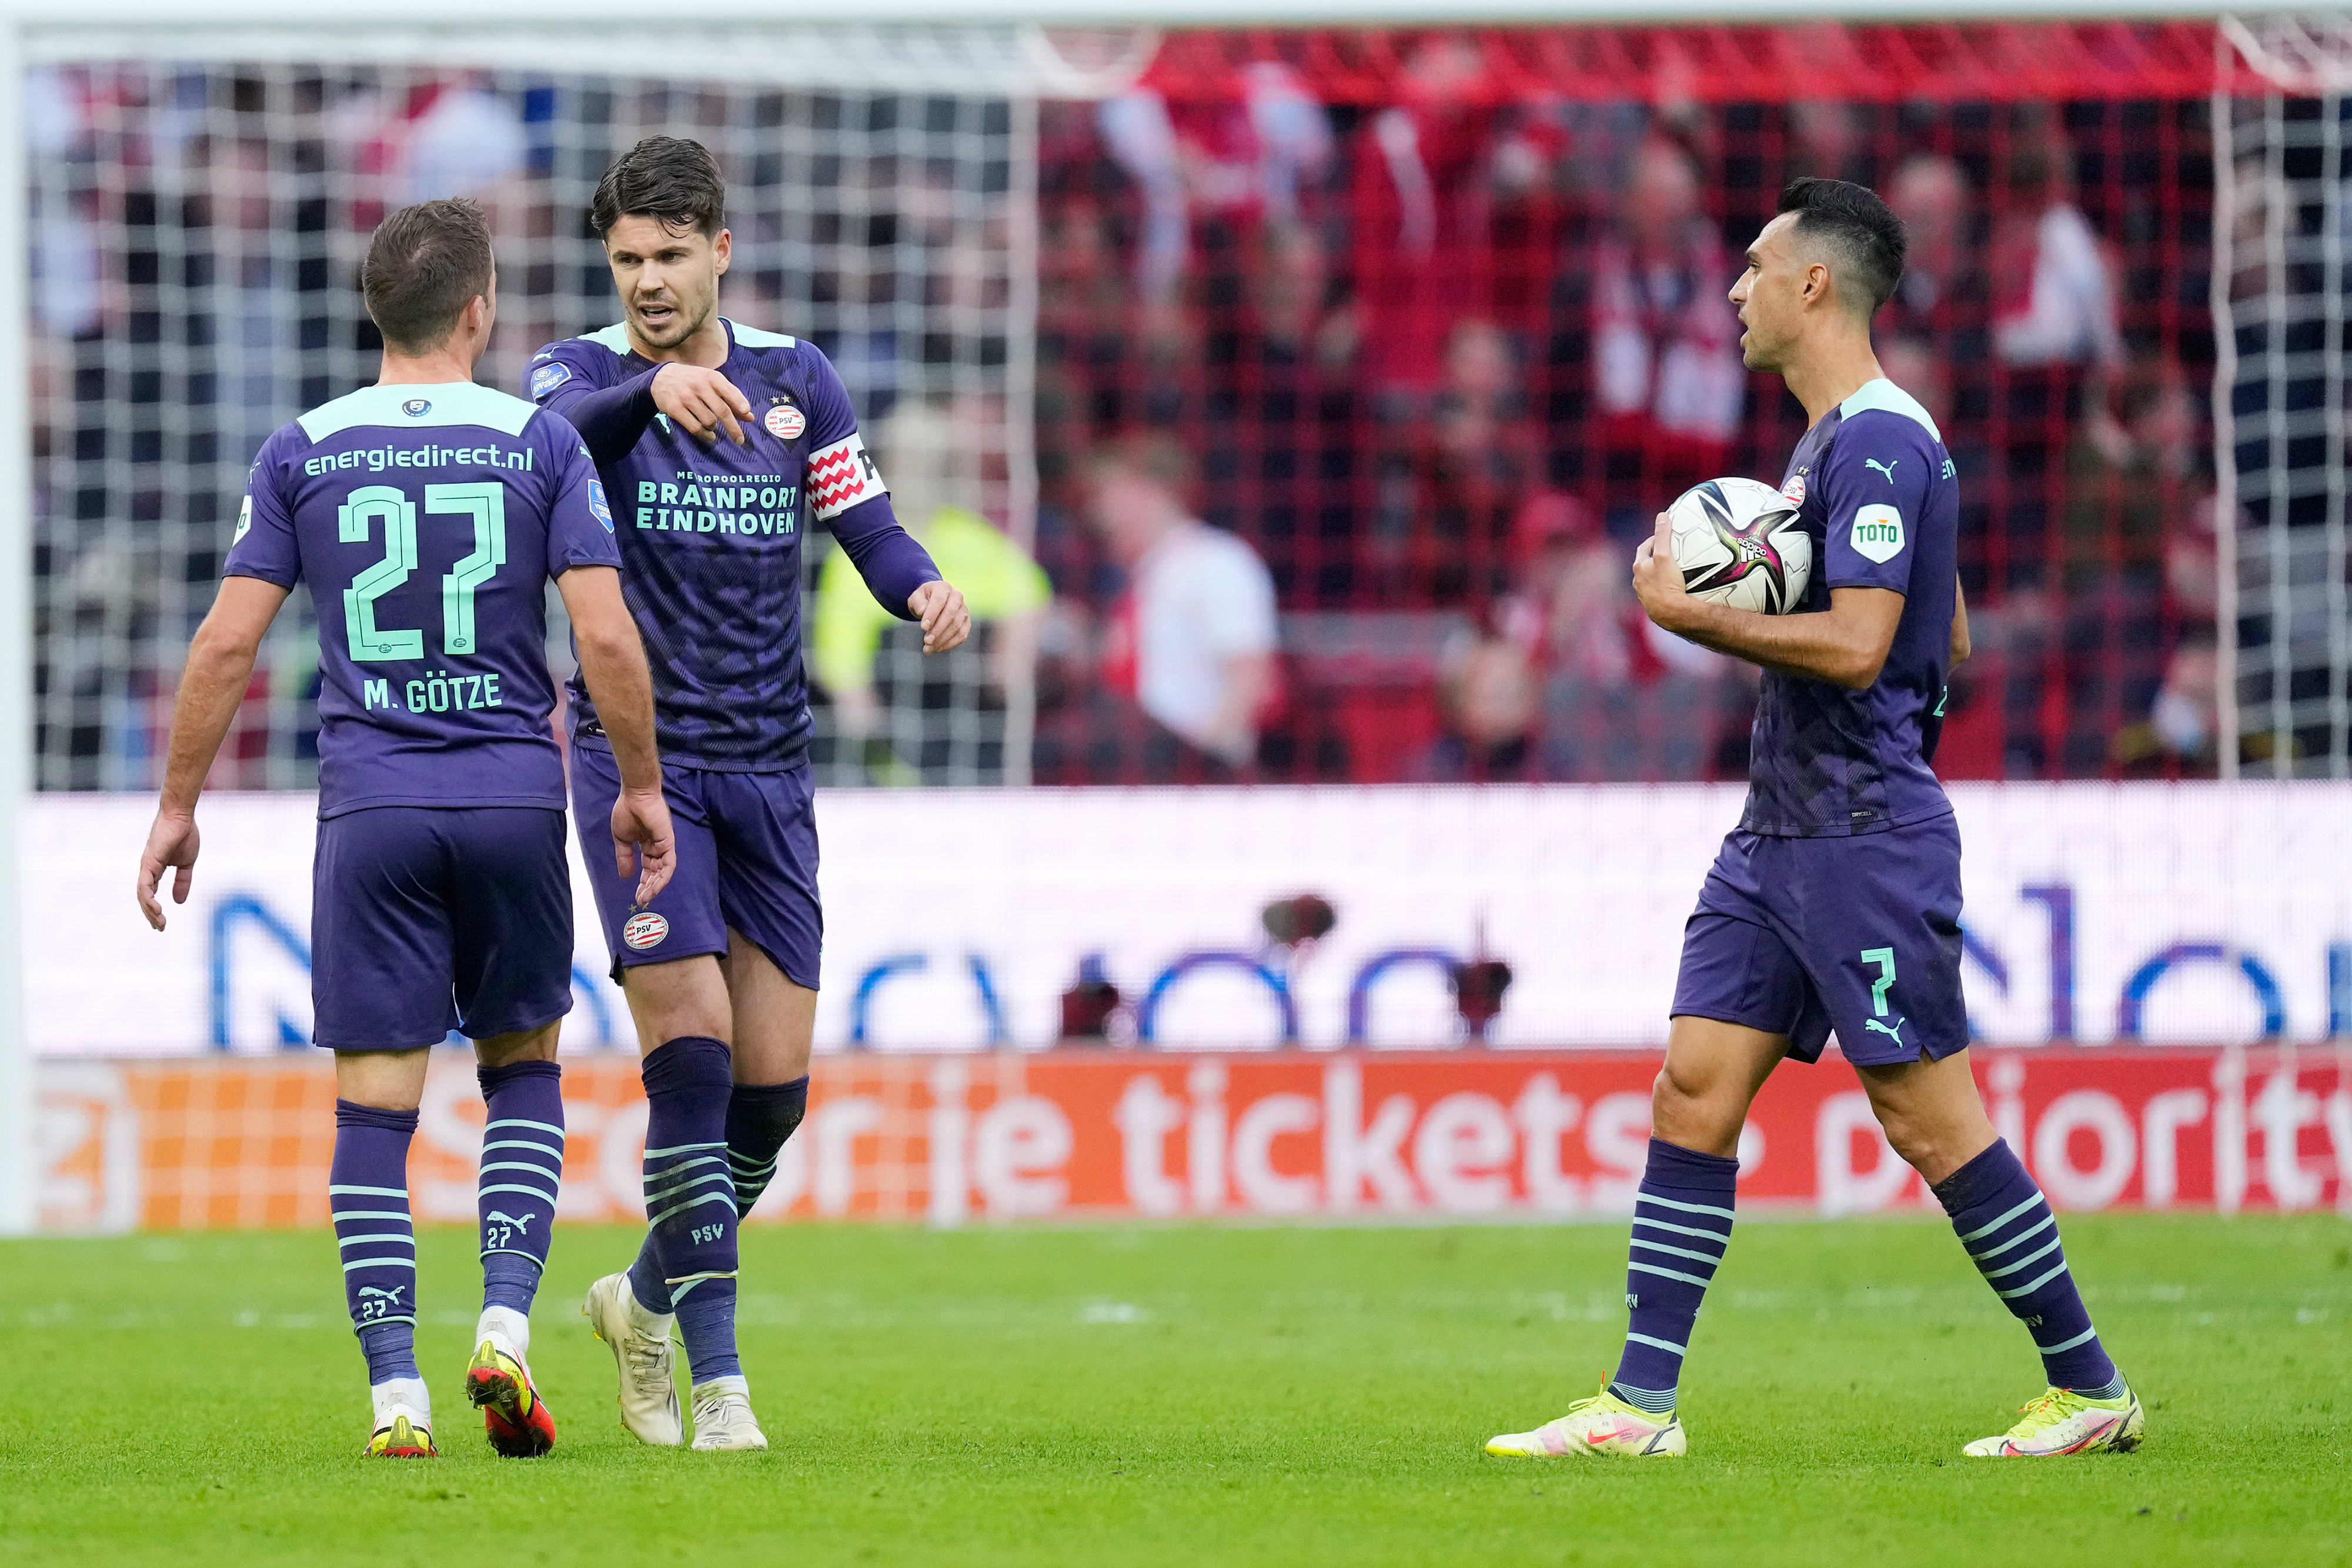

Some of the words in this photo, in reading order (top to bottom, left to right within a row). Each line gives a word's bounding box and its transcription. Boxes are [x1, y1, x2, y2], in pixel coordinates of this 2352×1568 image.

[305, 444, 533, 476] energiedirect.nl
[638, 481, 796, 509] BRAINPORT
[636, 507, 794, 534] EINDHOVEN
[1857, 524, 1897, 543] TOTO
[1736, 537, 1767, 556] adidas
[338, 482, 506, 661] 27
[364, 678, 399, 710] M.
[406, 670, 502, 713] GÖTZE
[636, 924, 651, 934] PSV
[1860, 947, 1897, 1017] 7
[1112, 1056, 1655, 1216] tickets
[487, 1226, 511, 1249] 27
[691, 1223, 724, 1246] PSV
[362, 1299, 386, 1320] 27
